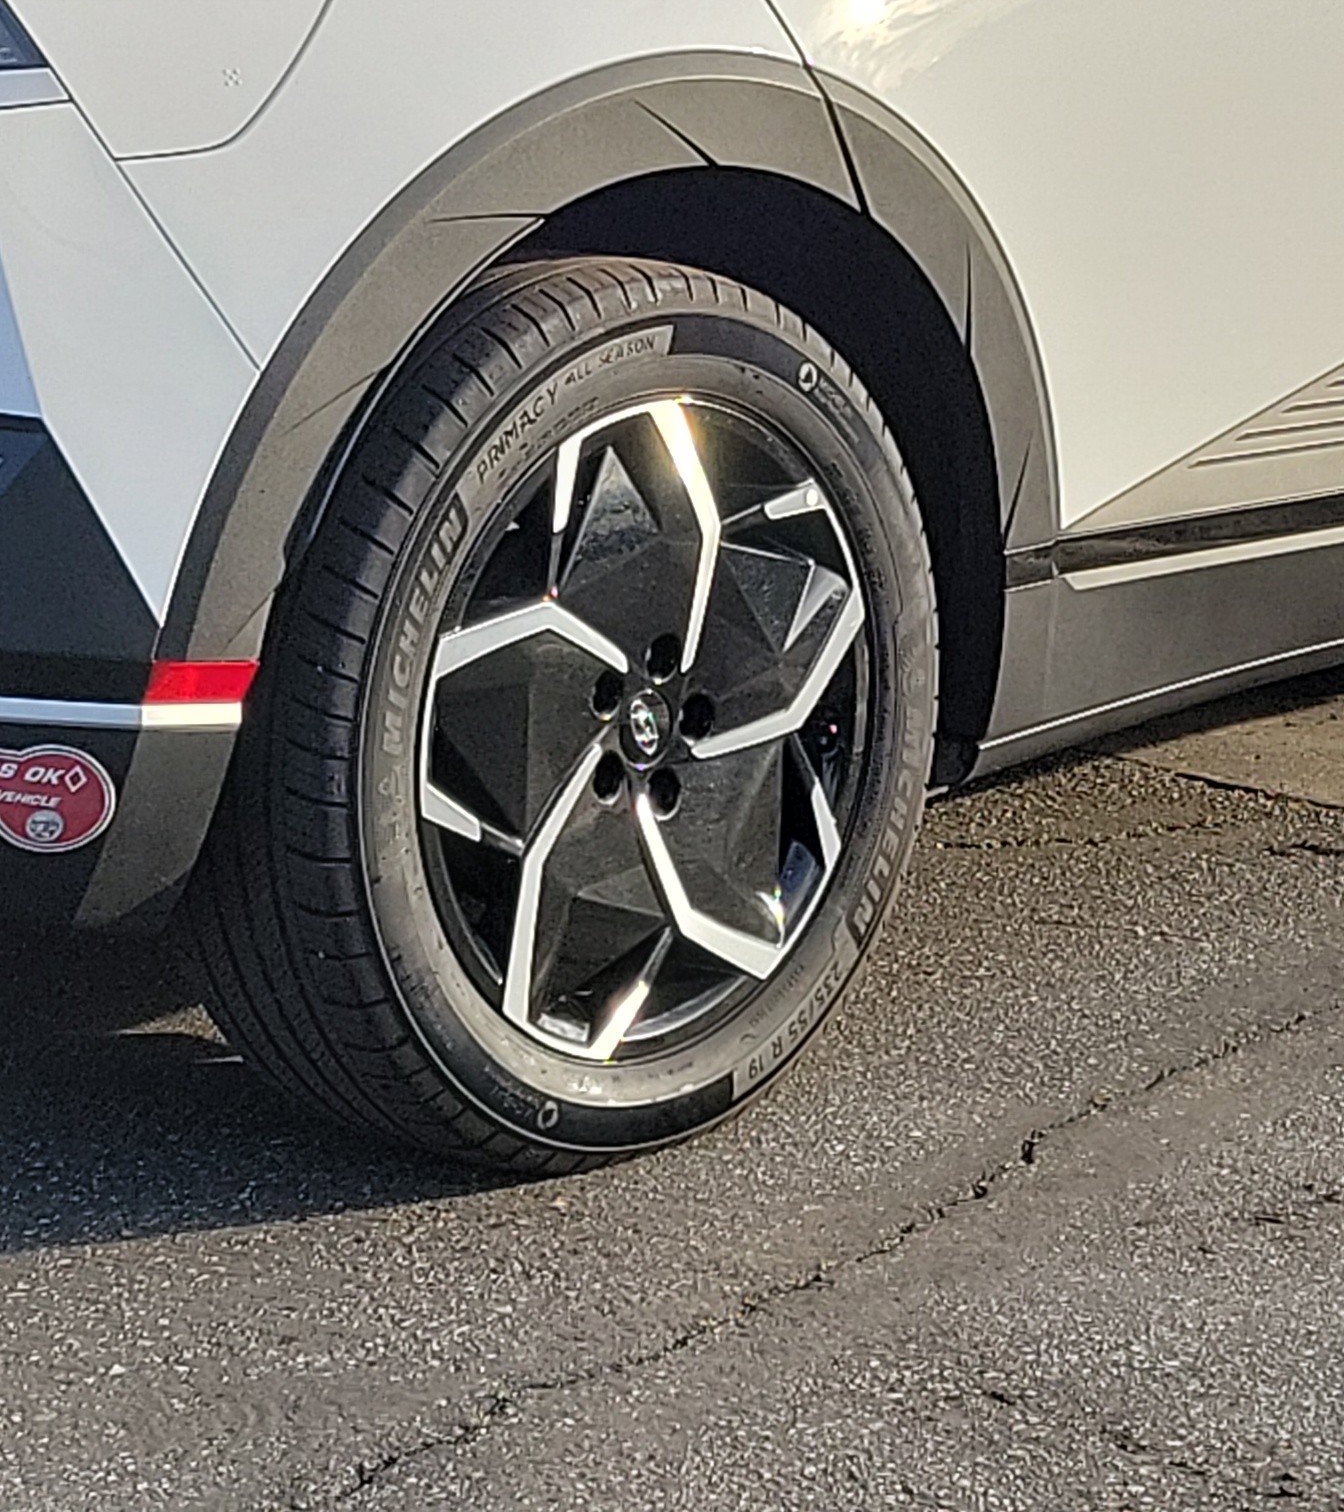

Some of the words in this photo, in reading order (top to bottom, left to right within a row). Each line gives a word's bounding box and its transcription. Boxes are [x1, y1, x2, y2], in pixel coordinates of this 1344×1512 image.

[475, 382, 559, 485] PRIMACY
[564, 365, 593, 387] ALL
[598, 334, 657, 365] SEASON
[382, 506, 463, 756] MICHELIN
[23, 765, 66, 786] OK
[787, 960, 844, 1043] 235/55
[748, 1053, 765, 1080] 19
[770, 1035, 784, 1059] R
